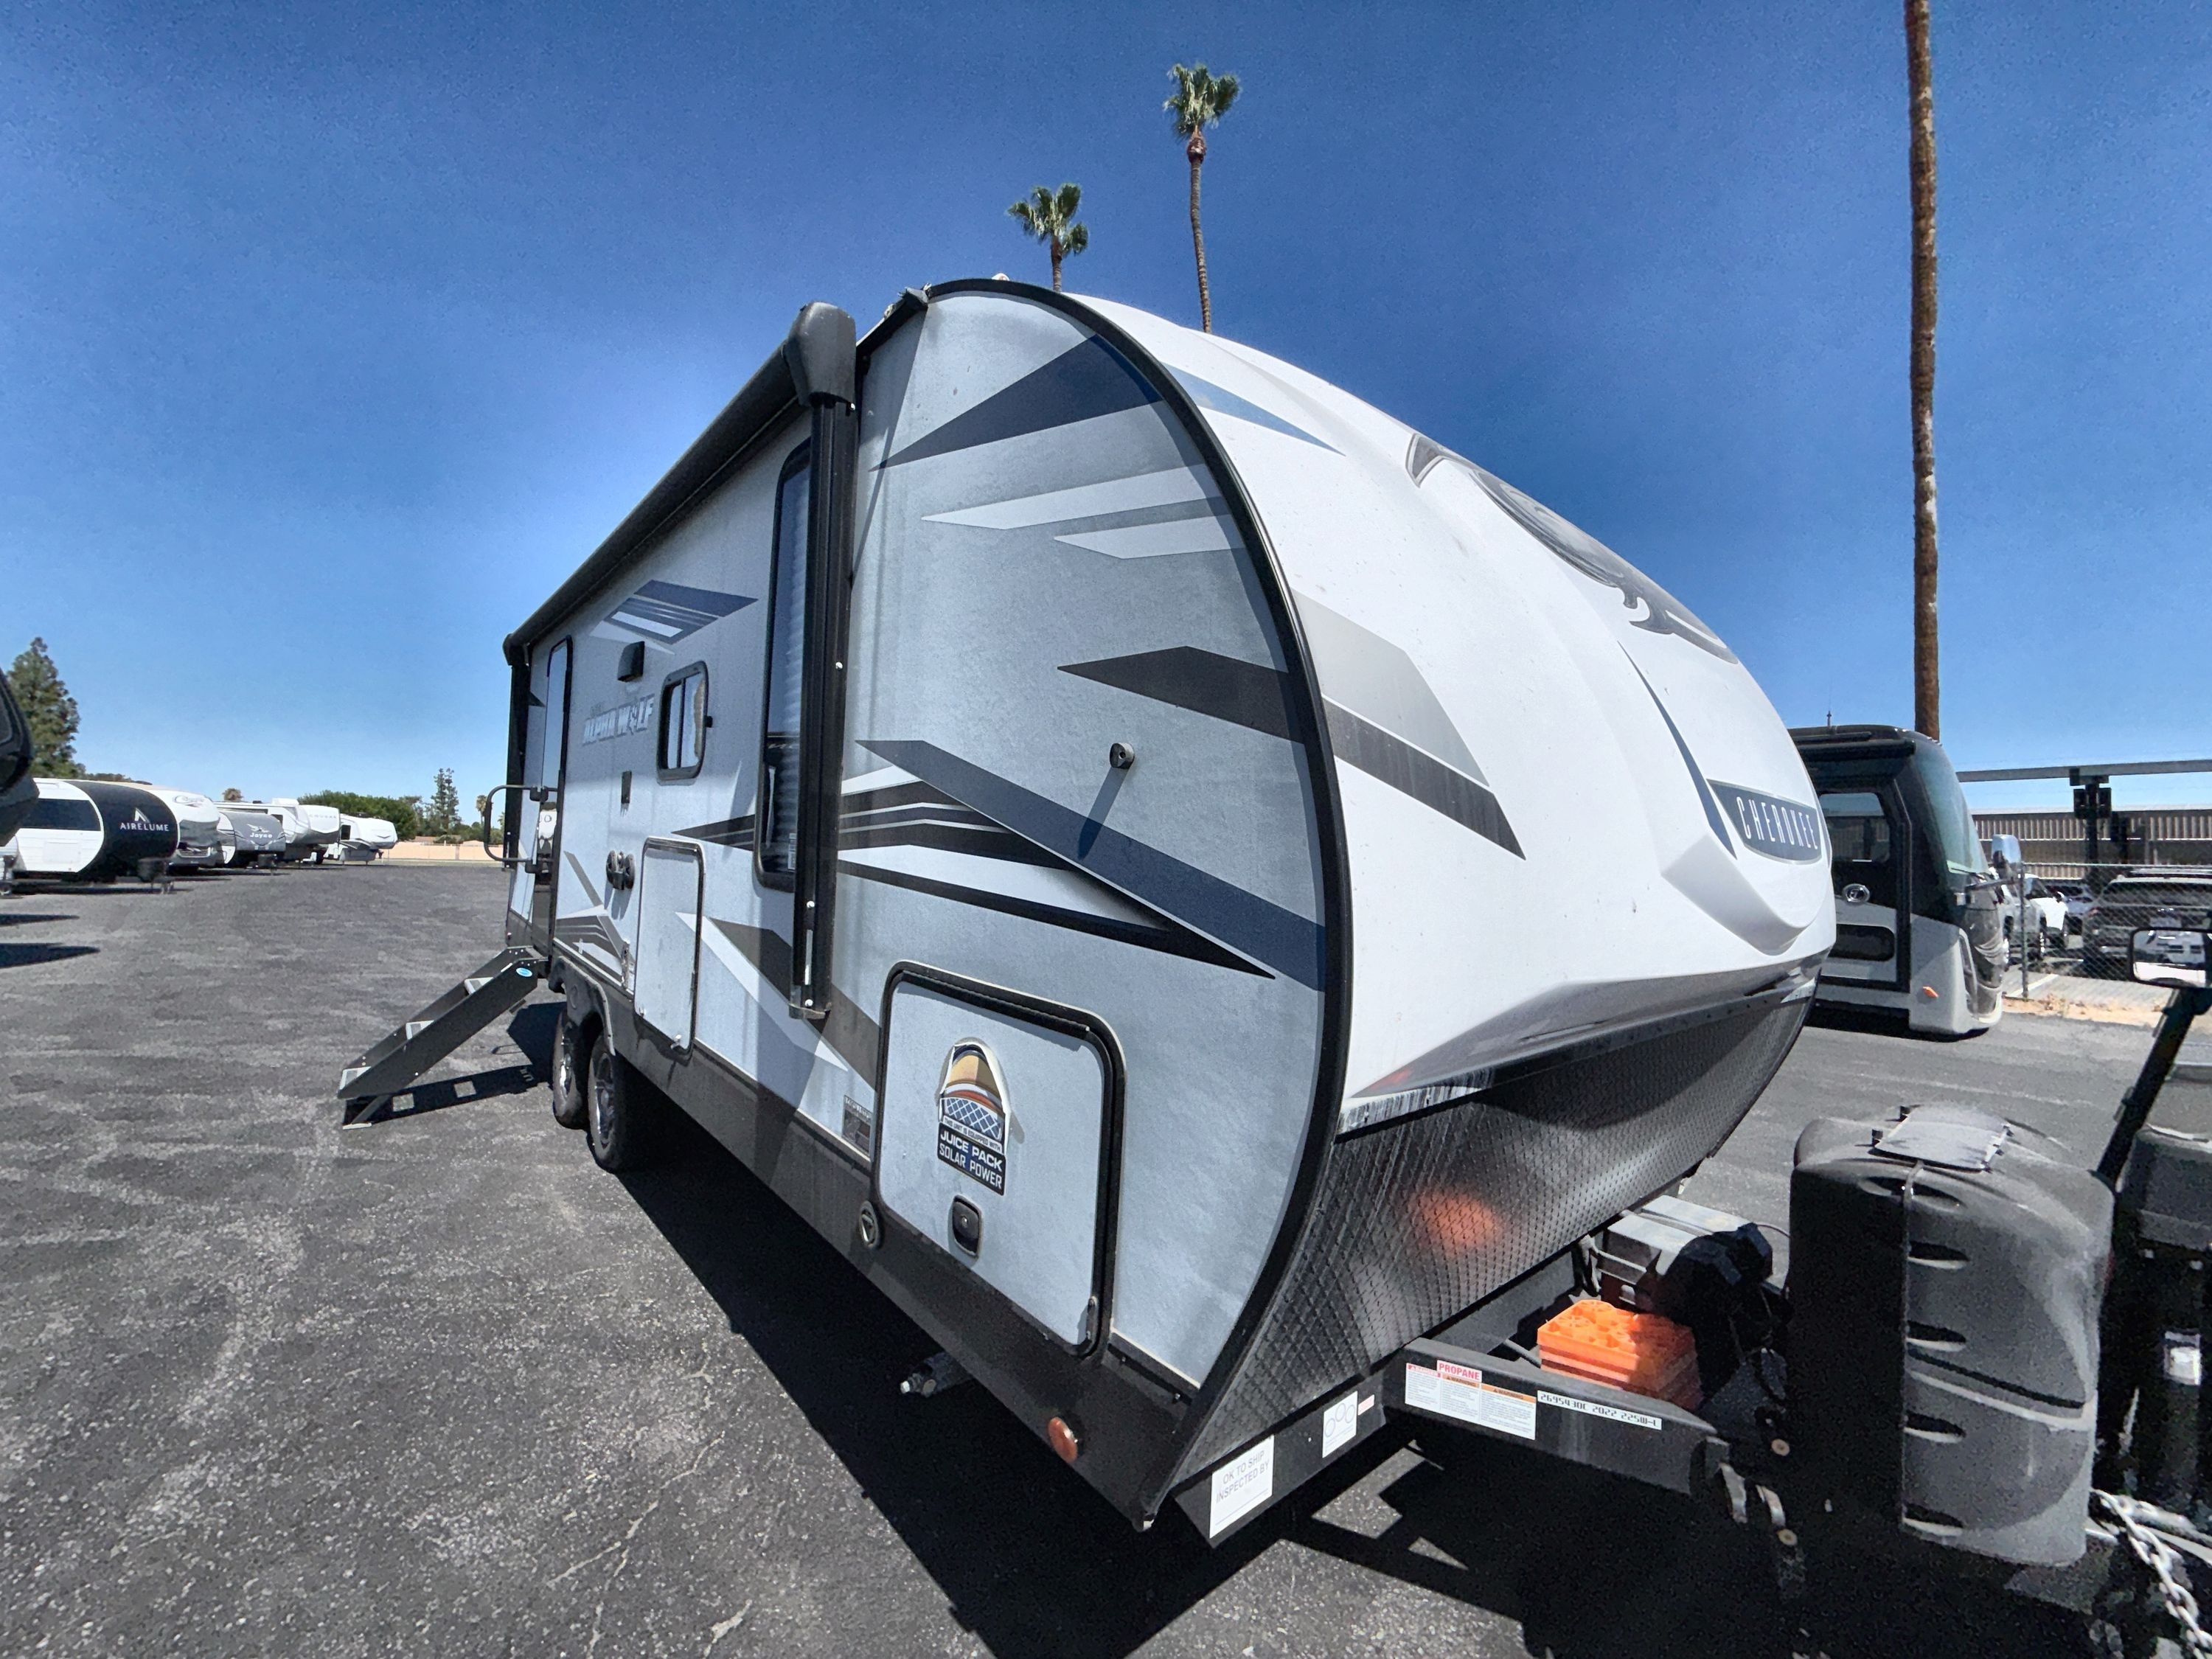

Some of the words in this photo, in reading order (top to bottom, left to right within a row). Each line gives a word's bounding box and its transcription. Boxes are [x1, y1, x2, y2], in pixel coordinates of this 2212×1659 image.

[120, 822, 170, 832] AIRELUME
[1736, 796, 1818, 850] CHEROKEE
[940, 1130, 969, 1152] JUICE
[972, 1146, 1003, 1172] PACK
[939, 1143, 966, 1168] SOLAR
[970, 1160, 1002, 1189] POWER
[1439, 1363, 1481, 1380] PROPANE
[1451, 1377, 1477, 1387] WARNING
[1498, 1389, 1523, 1399] WARNING
[1593, 1405, 1617, 1417] 2022
[1223, 1470, 1234, 1484] OK
[1237, 1462, 1246, 1475] TO
[1248, 1450, 1265, 1469] SHIP
[1216, 1468, 1259, 1503] INSPECTED
[1260, 1458, 1270, 1475] BY
